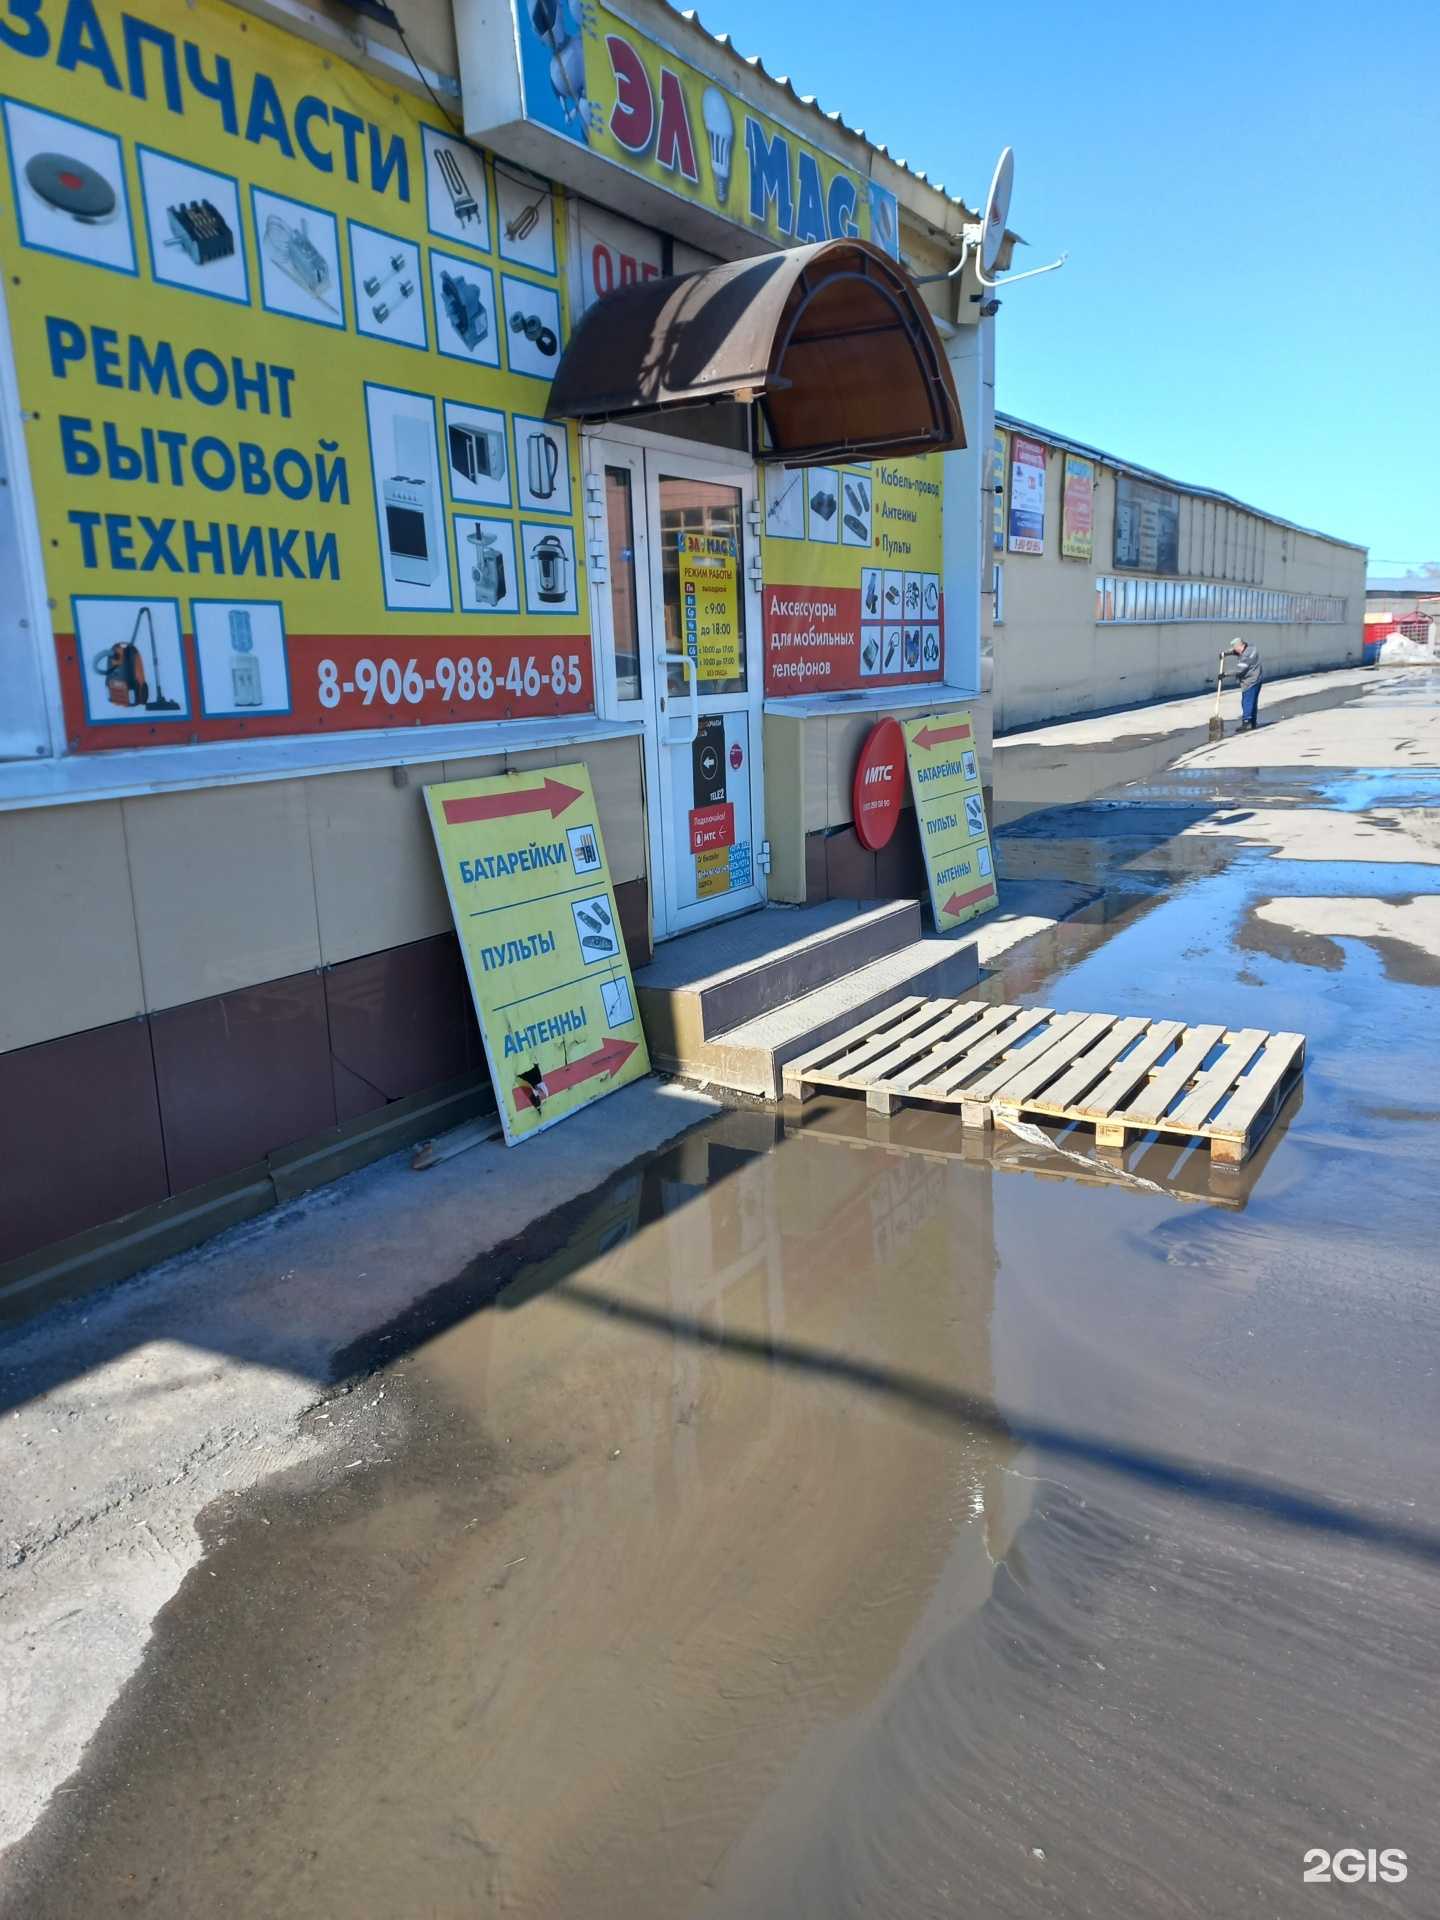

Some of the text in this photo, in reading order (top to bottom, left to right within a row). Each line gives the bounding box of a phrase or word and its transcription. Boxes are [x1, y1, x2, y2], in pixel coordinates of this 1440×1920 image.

[0, 0, 410, 202] ЗАПЧАСТИ
[605, 34, 698, 183] ЭЛ
[45, 315, 295, 418] РЕМОНТ
[58, 414, 350, 505] БЫТОВОЙ
[882, 500, 917, 522] Антенны
[67, 510, 340, 581] ТЕХНИКИ
[882, 534, 911, 557] Пульты
[684, 568, 733, 580] РЕЖИМ РАБОТЫ
[710, 602, 726, 615] 9:00
[771, 595, 837, 622] Аксессуары
[712, 622, 731, 635] 18:00
[771, 626, 854, 650] для мобильных
[317, 655, 582, 708] 8-906-988-46-85
[772, 657, 831, 681] телефонов
[917, 760, 963, 783] БАТАРЕЙКИ
[710, 788, 725, 801] TELE2
[926, 814, 958, 835] ПУЛЬТЫ
[459, 841, 568, 884] БАТАРЕЙКИ
[936, 861, 972, 886] АНТЕННЫ
[481, 930, 556, 971] ПУЛЬТЫ
[504, 1006, 587, 1057] АНТЕННЫ
